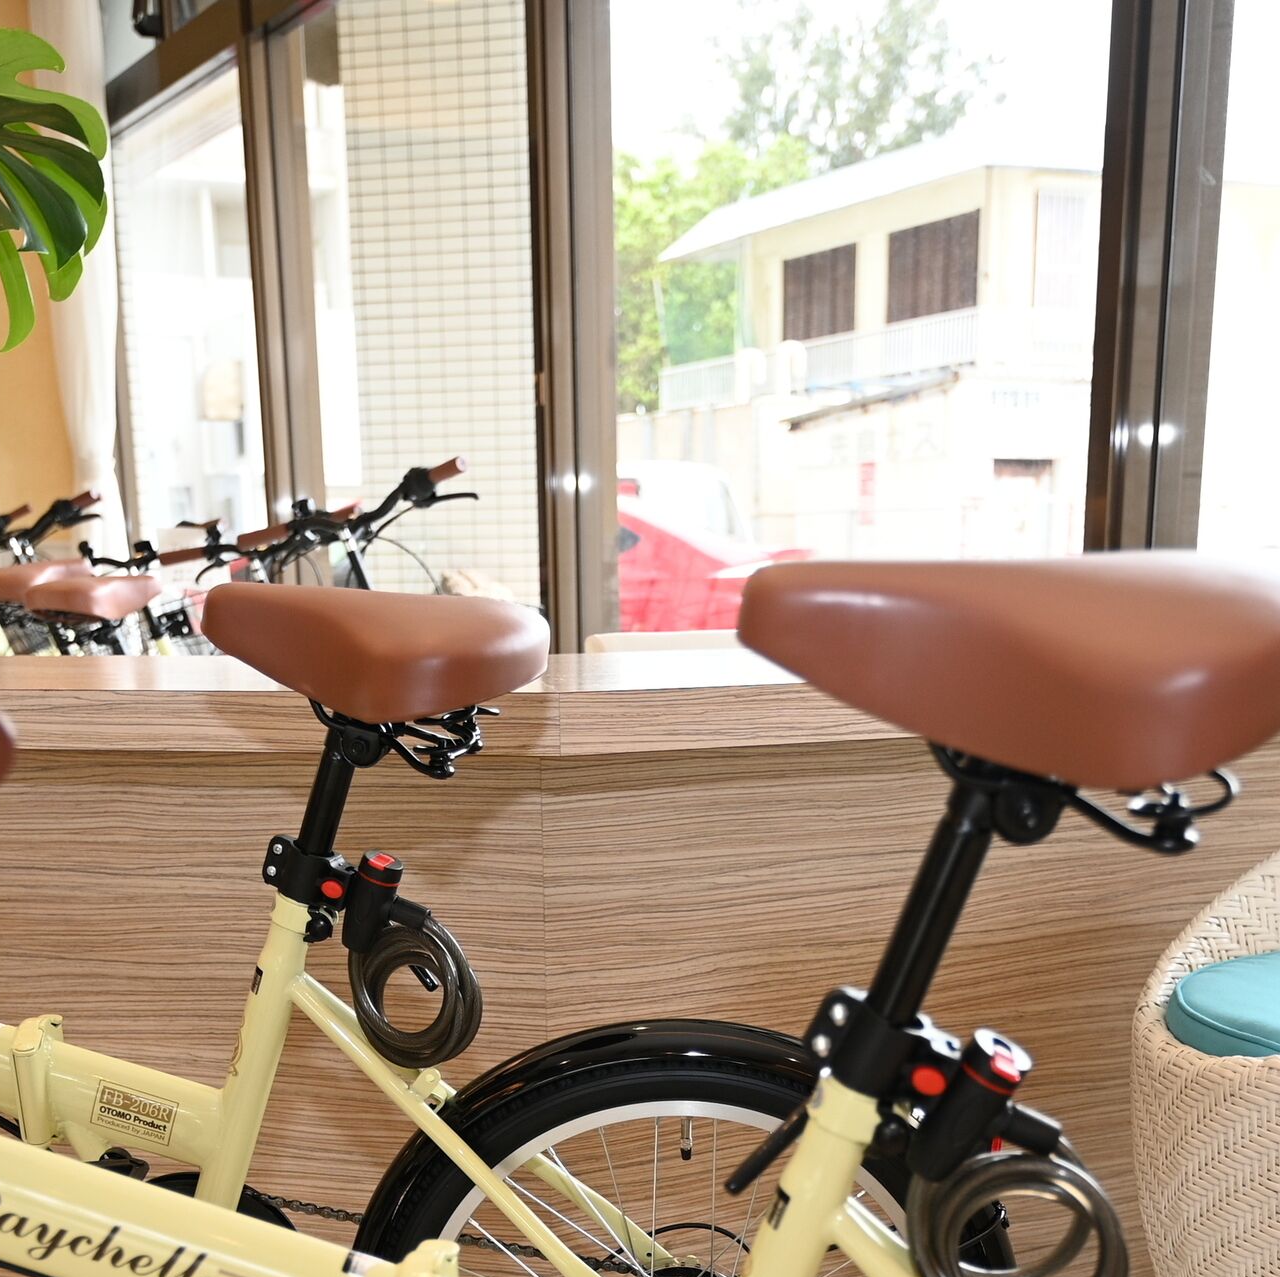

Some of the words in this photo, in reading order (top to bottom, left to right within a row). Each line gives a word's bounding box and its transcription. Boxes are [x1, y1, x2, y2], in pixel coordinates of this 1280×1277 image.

[102, 1087, 170, 1121] FB-206R
[97, 1116, 130, 1131] Produced
[131, 1126, 140, 1135] by
[141, 1129, 166, 1141] JAPAN
[99, 1105, 132, 1121] OTOMO
[133, 1115, 167, 1132] Product
